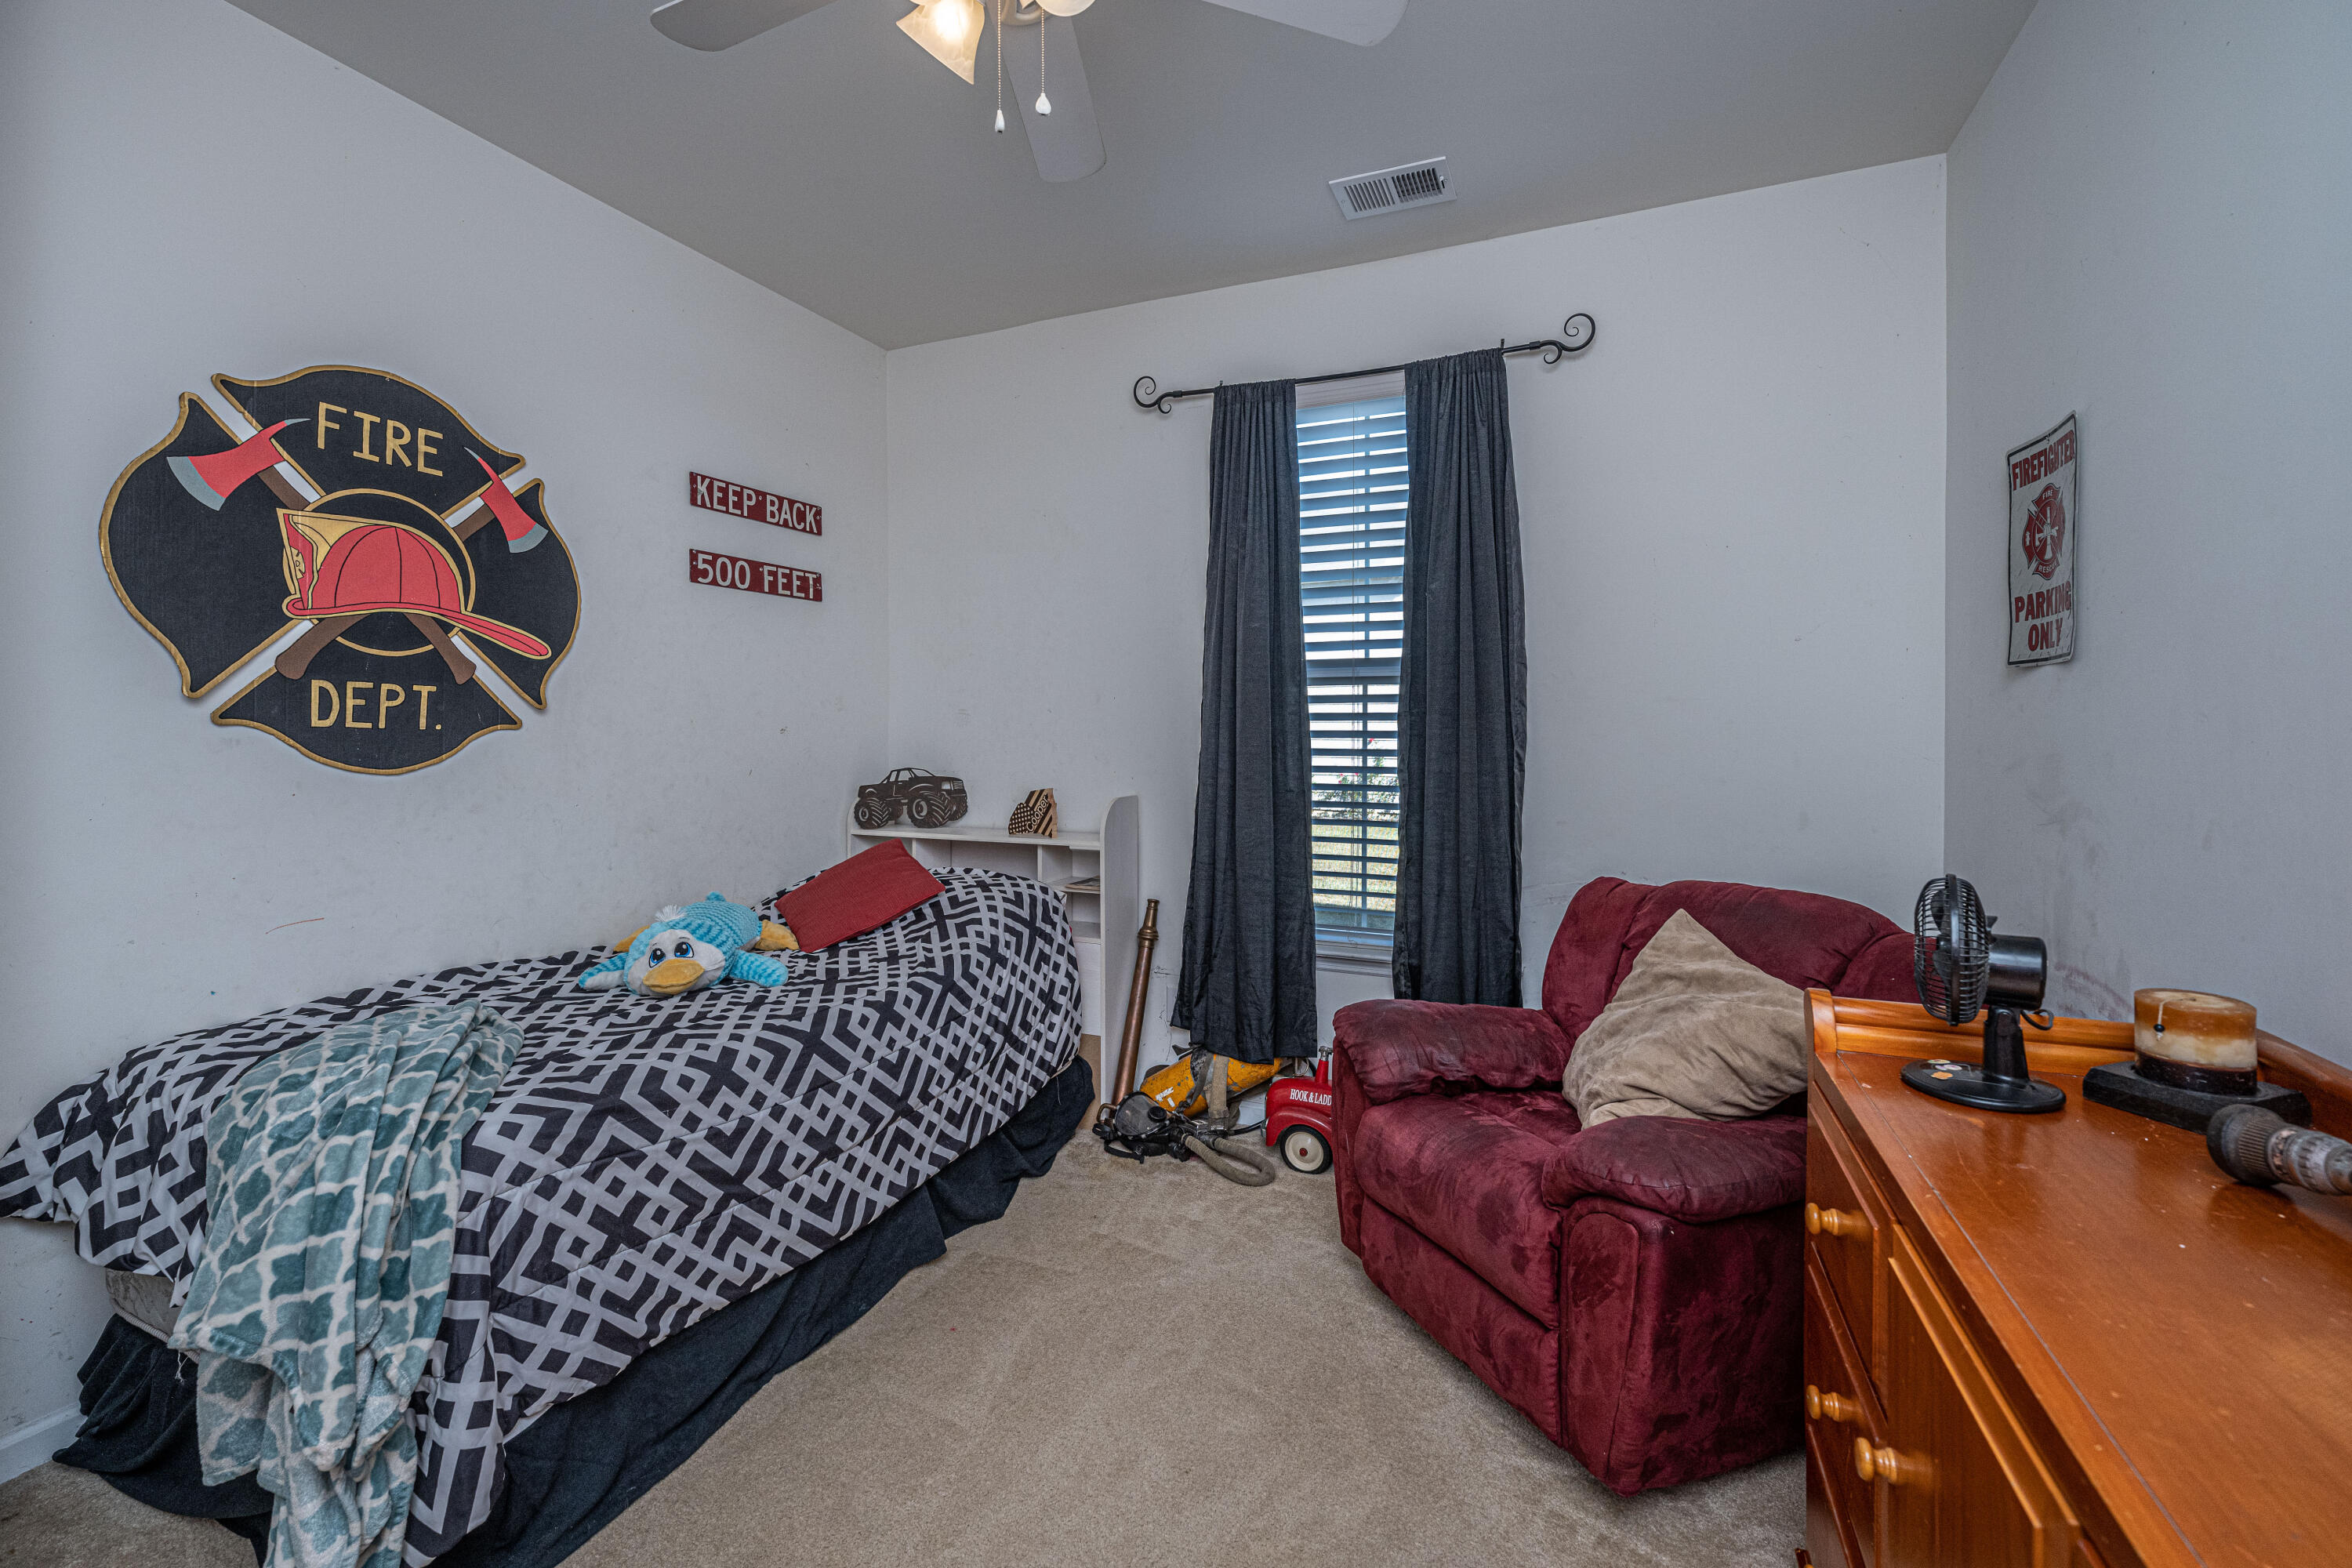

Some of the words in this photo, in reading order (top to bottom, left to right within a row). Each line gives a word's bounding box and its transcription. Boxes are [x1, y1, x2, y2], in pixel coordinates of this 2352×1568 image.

[318, 401, 444, 477] FIRE
[2011, 430, 2075, 492] FIREFIGHTER
[696, 475, 757, 517] KEEP
[766, 494, 818, 534] BACK
[2042, 489, 2053, 500] FIRE
[697, 553, 751, 590] 500
[763, 564, 817, 599] FEET
[2014, 581, 2071, 623] PARKING
[2027, 618, 2063, 652] ONLY
[310, 679, 442, 730] DEPT.
[1026, 793, 1049, 832] Cooper
[1290, 1088, 1308, 1102] HOOK
[1308, 1091, 1314, 1103] &
[1314, 1092, 1332, 1106] LADD
